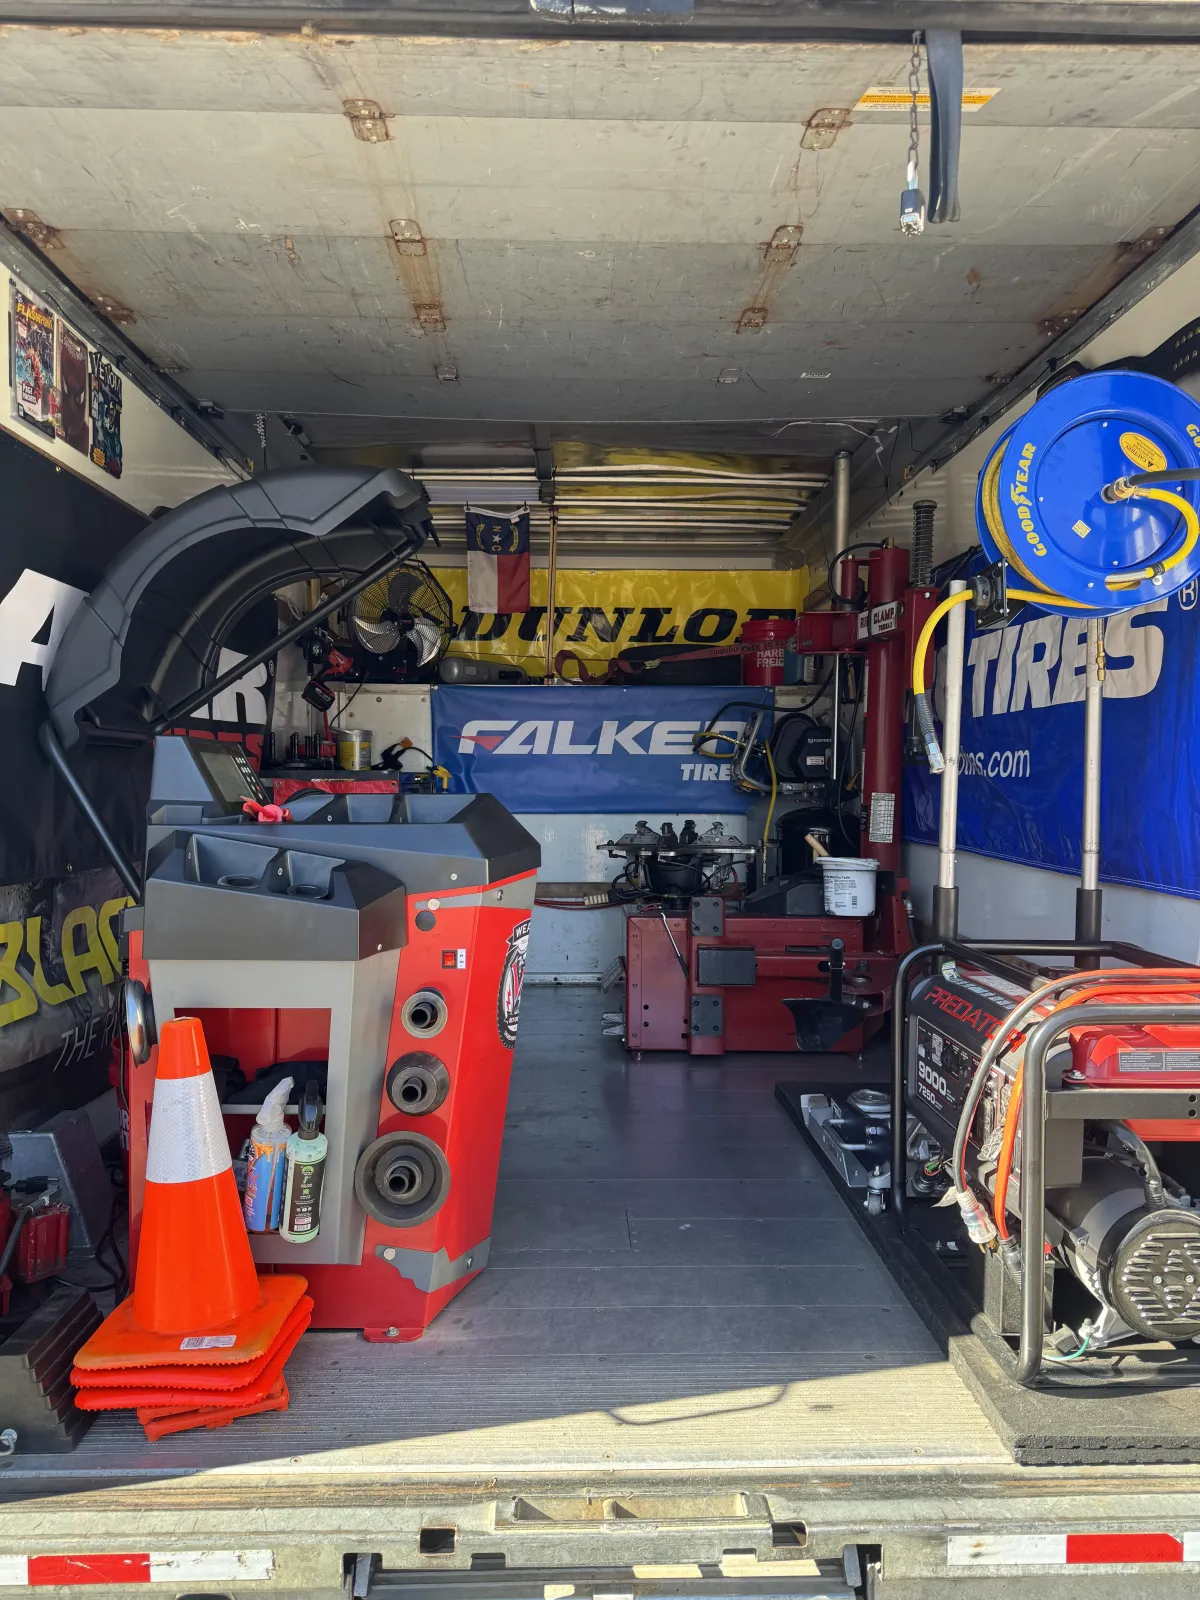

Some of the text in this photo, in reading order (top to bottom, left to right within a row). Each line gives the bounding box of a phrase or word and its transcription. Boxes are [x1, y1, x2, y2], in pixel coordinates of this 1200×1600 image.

[89, 351, 121, 391] VENOM
[1125, 445, 1147, 463] CAUTION
[1010, 442, 1047, 557] GOODYEAR
[873, 607, 895, 625] CLAMP
[967, 597, 1168, 718] TIRES
[681, 763, 732, 781] TIRE
[53, 1016, 100, 1072] THE
[918, 1060, 947, 1096] 9000
[918, 1081, 936, 1105] 7250
